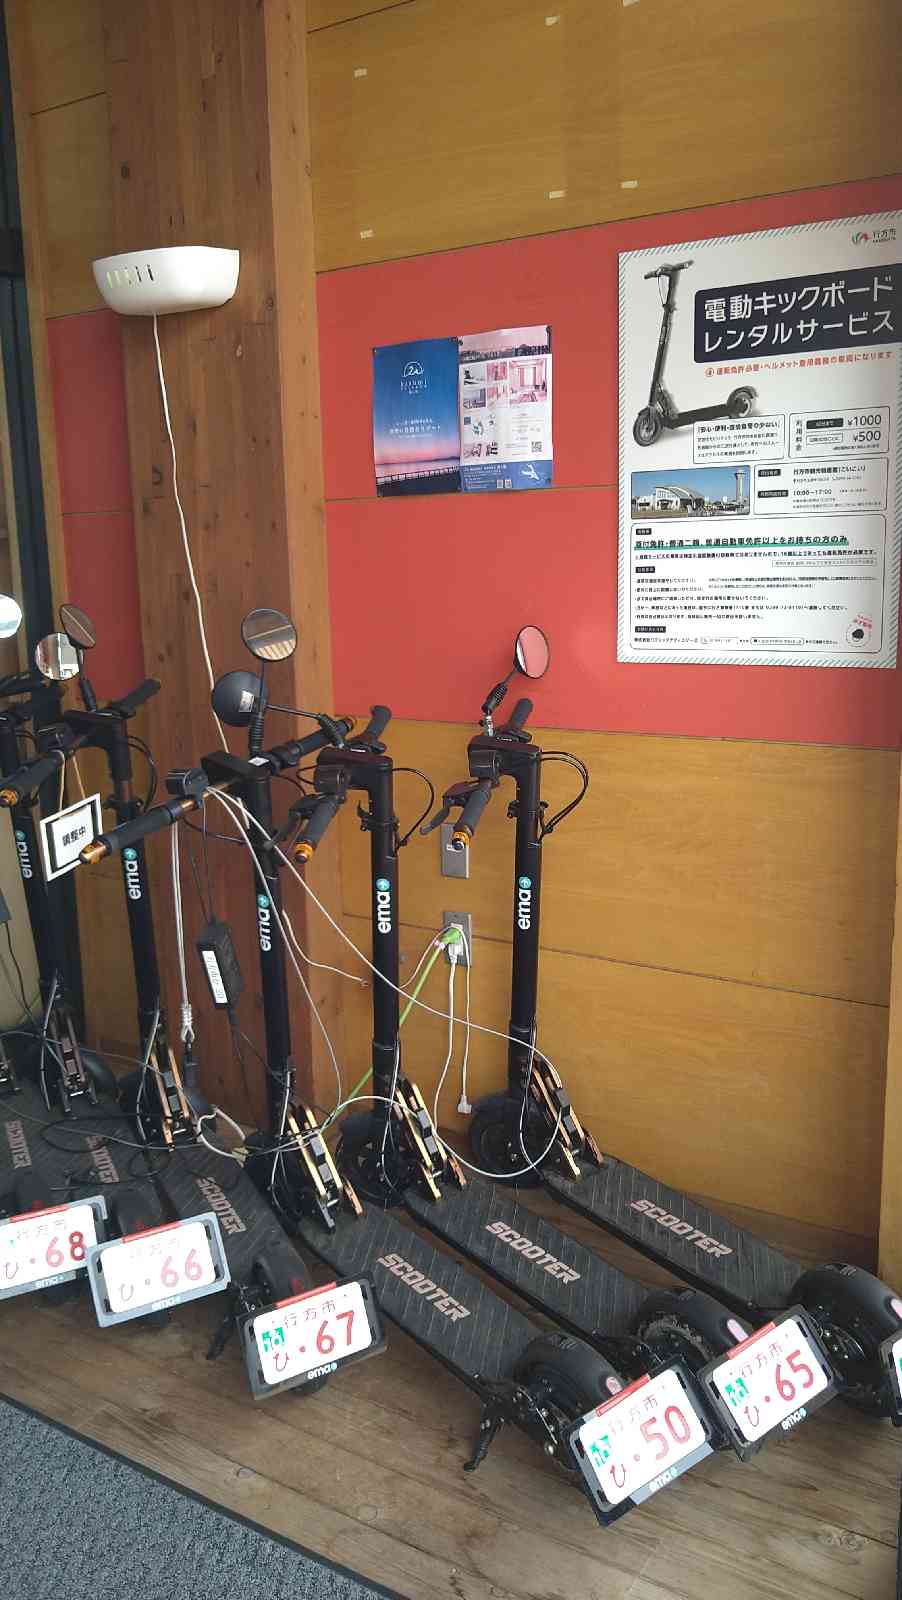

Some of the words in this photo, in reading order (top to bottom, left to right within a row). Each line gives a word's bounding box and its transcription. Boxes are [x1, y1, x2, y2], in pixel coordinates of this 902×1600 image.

[704, 276, 894, 323] 電動キックボード
[705, 310, 894, 353] レンタルサービス
[485, 1220, 581, 1285] SCOOTER
[630, 1199, 733, 1259] SCOOTER
[376, 1253, 471, 1323] SCOOTER
